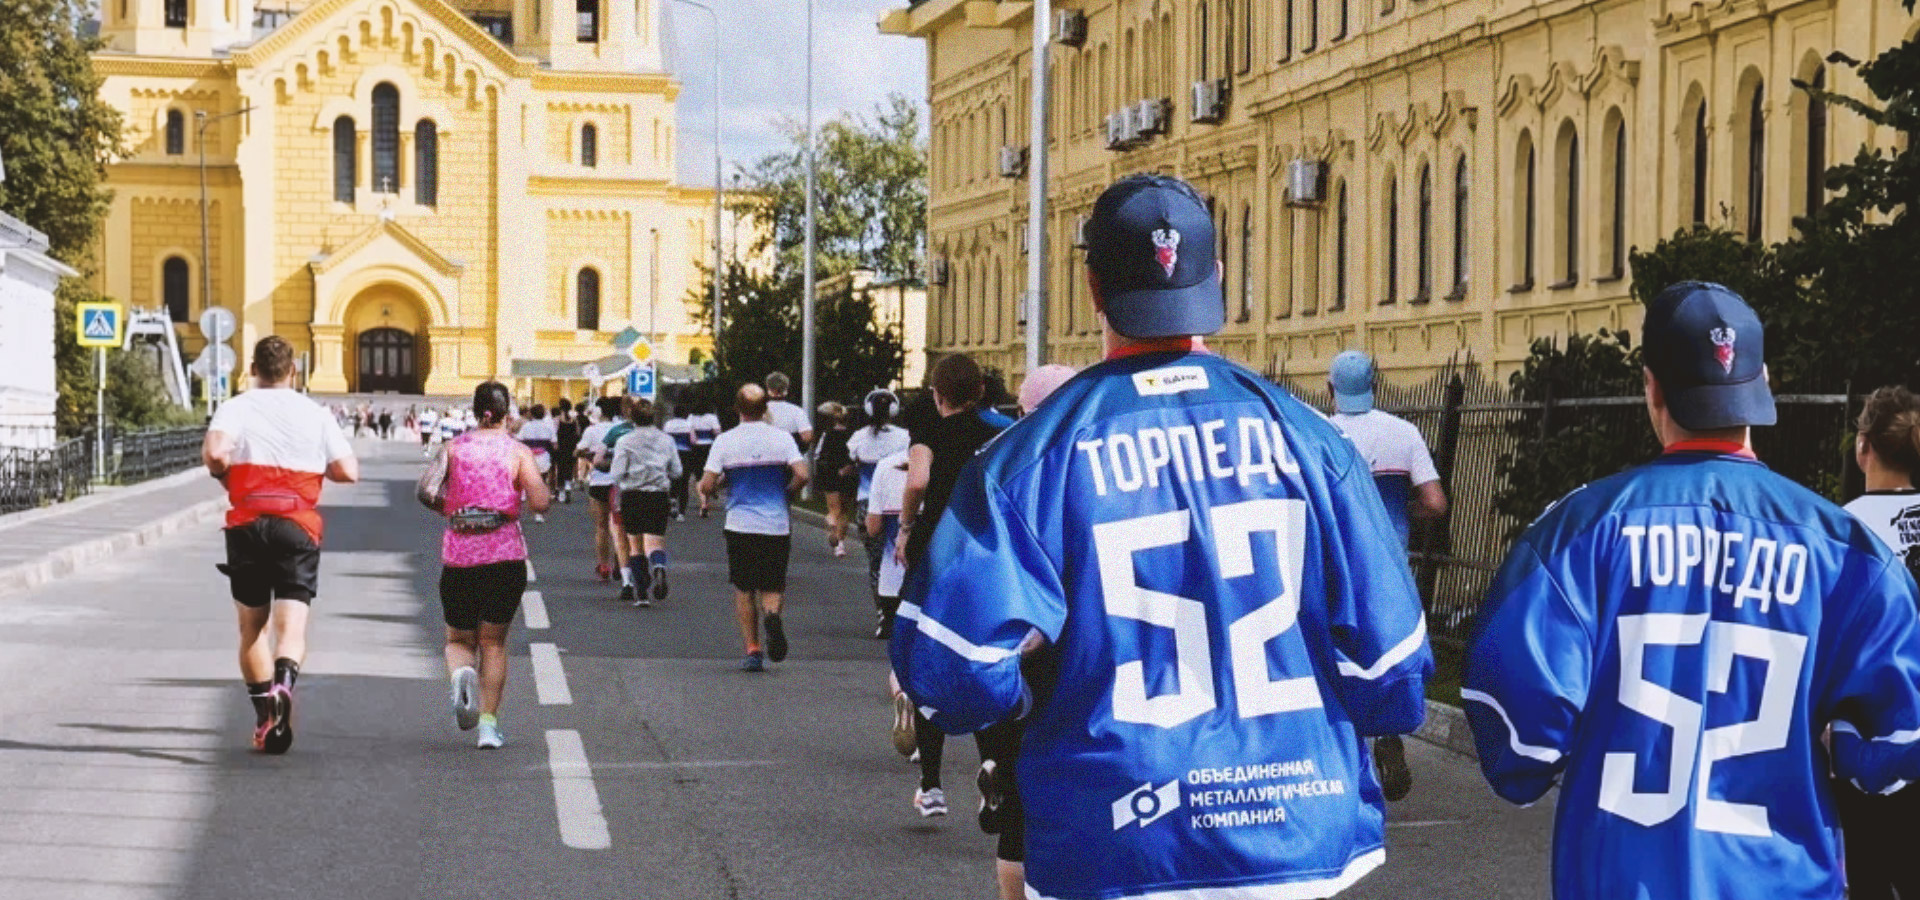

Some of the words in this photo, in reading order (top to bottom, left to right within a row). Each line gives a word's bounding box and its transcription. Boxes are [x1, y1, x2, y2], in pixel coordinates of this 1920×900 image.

[636, 373, 650, 391] P
[1622, 524, 1808, 613] ТОРПЕДО
[1093, 499, 1323, 728] 52
[1599, 614, 1808, 836] 52
[1187, 759, 1314, 785] ОБЪЕДИНЕННАЯ
[1191, 807, 1286, 829] КОМПАНИЯ
